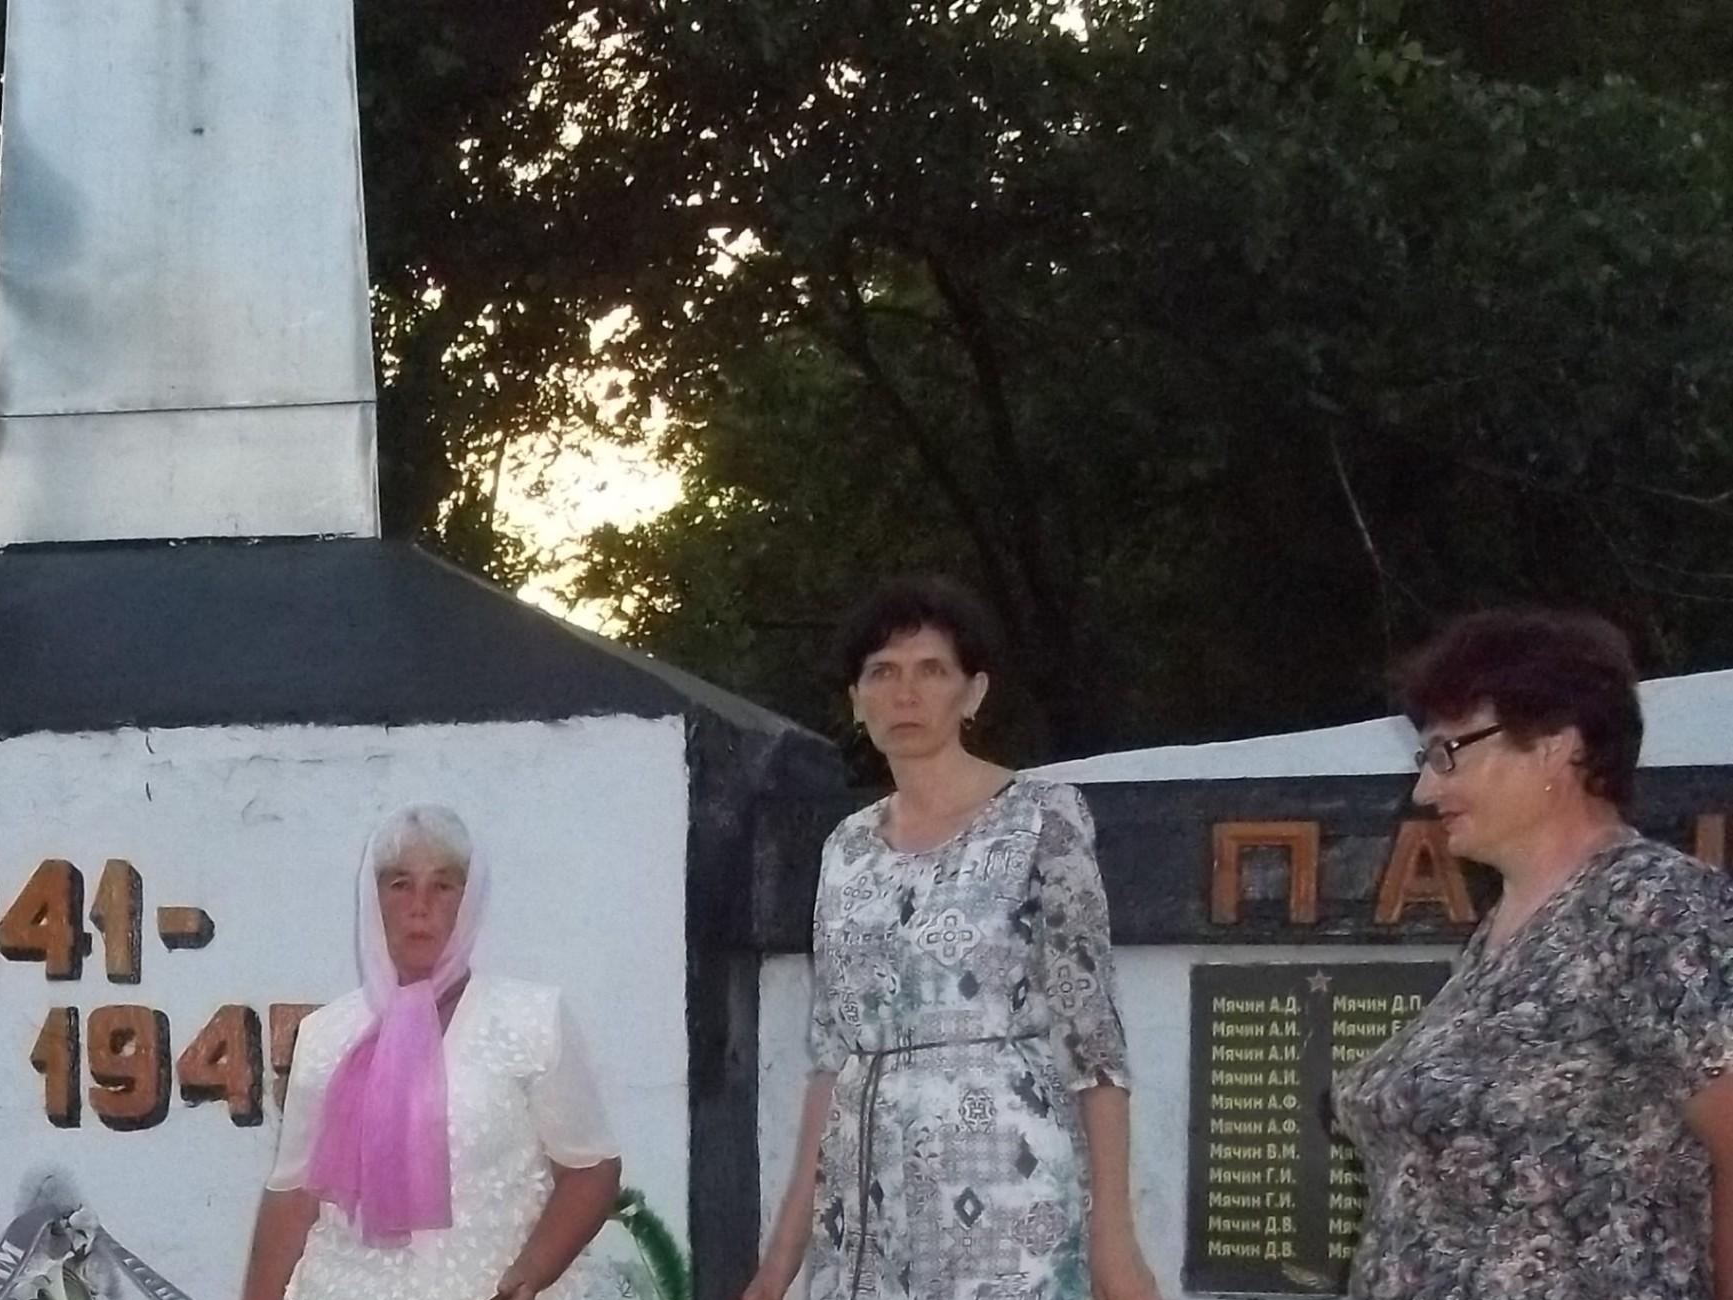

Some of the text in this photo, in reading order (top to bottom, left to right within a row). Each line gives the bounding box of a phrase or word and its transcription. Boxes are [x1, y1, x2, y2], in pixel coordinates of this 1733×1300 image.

[1213, 996, 1301, 1016] Мячин А.Д.
[1332, 995, 1387, 1012] Мячин
[1212, 1021, 1301, 1037] Мячин А.И.
[1332, 1020, 1386, 1036] Мячин
[1211, 1046, 1301, 1061] Мячин А.И.
[30, 1003, 326, 1132] 194
[1211, 1070, 1300, 1086] Мячин А.И.
[1210, 1093, 1301, 1110] Мячин А.Ф.
[1210, 1118, 1301, 1134] Мячин А.Ф.
[1209, 1143, 1300, 1160] Мячин В.М.
[1209, 1168, 1297, 1184] Мячин Г.И.
[1208, 1192, 1296, 1208] Мячин Г.И.
[1208, 1215, 1297, 1236] Мячин Д.В.
[1207, 1240, 1297, 1260] Мячин Д.В.
